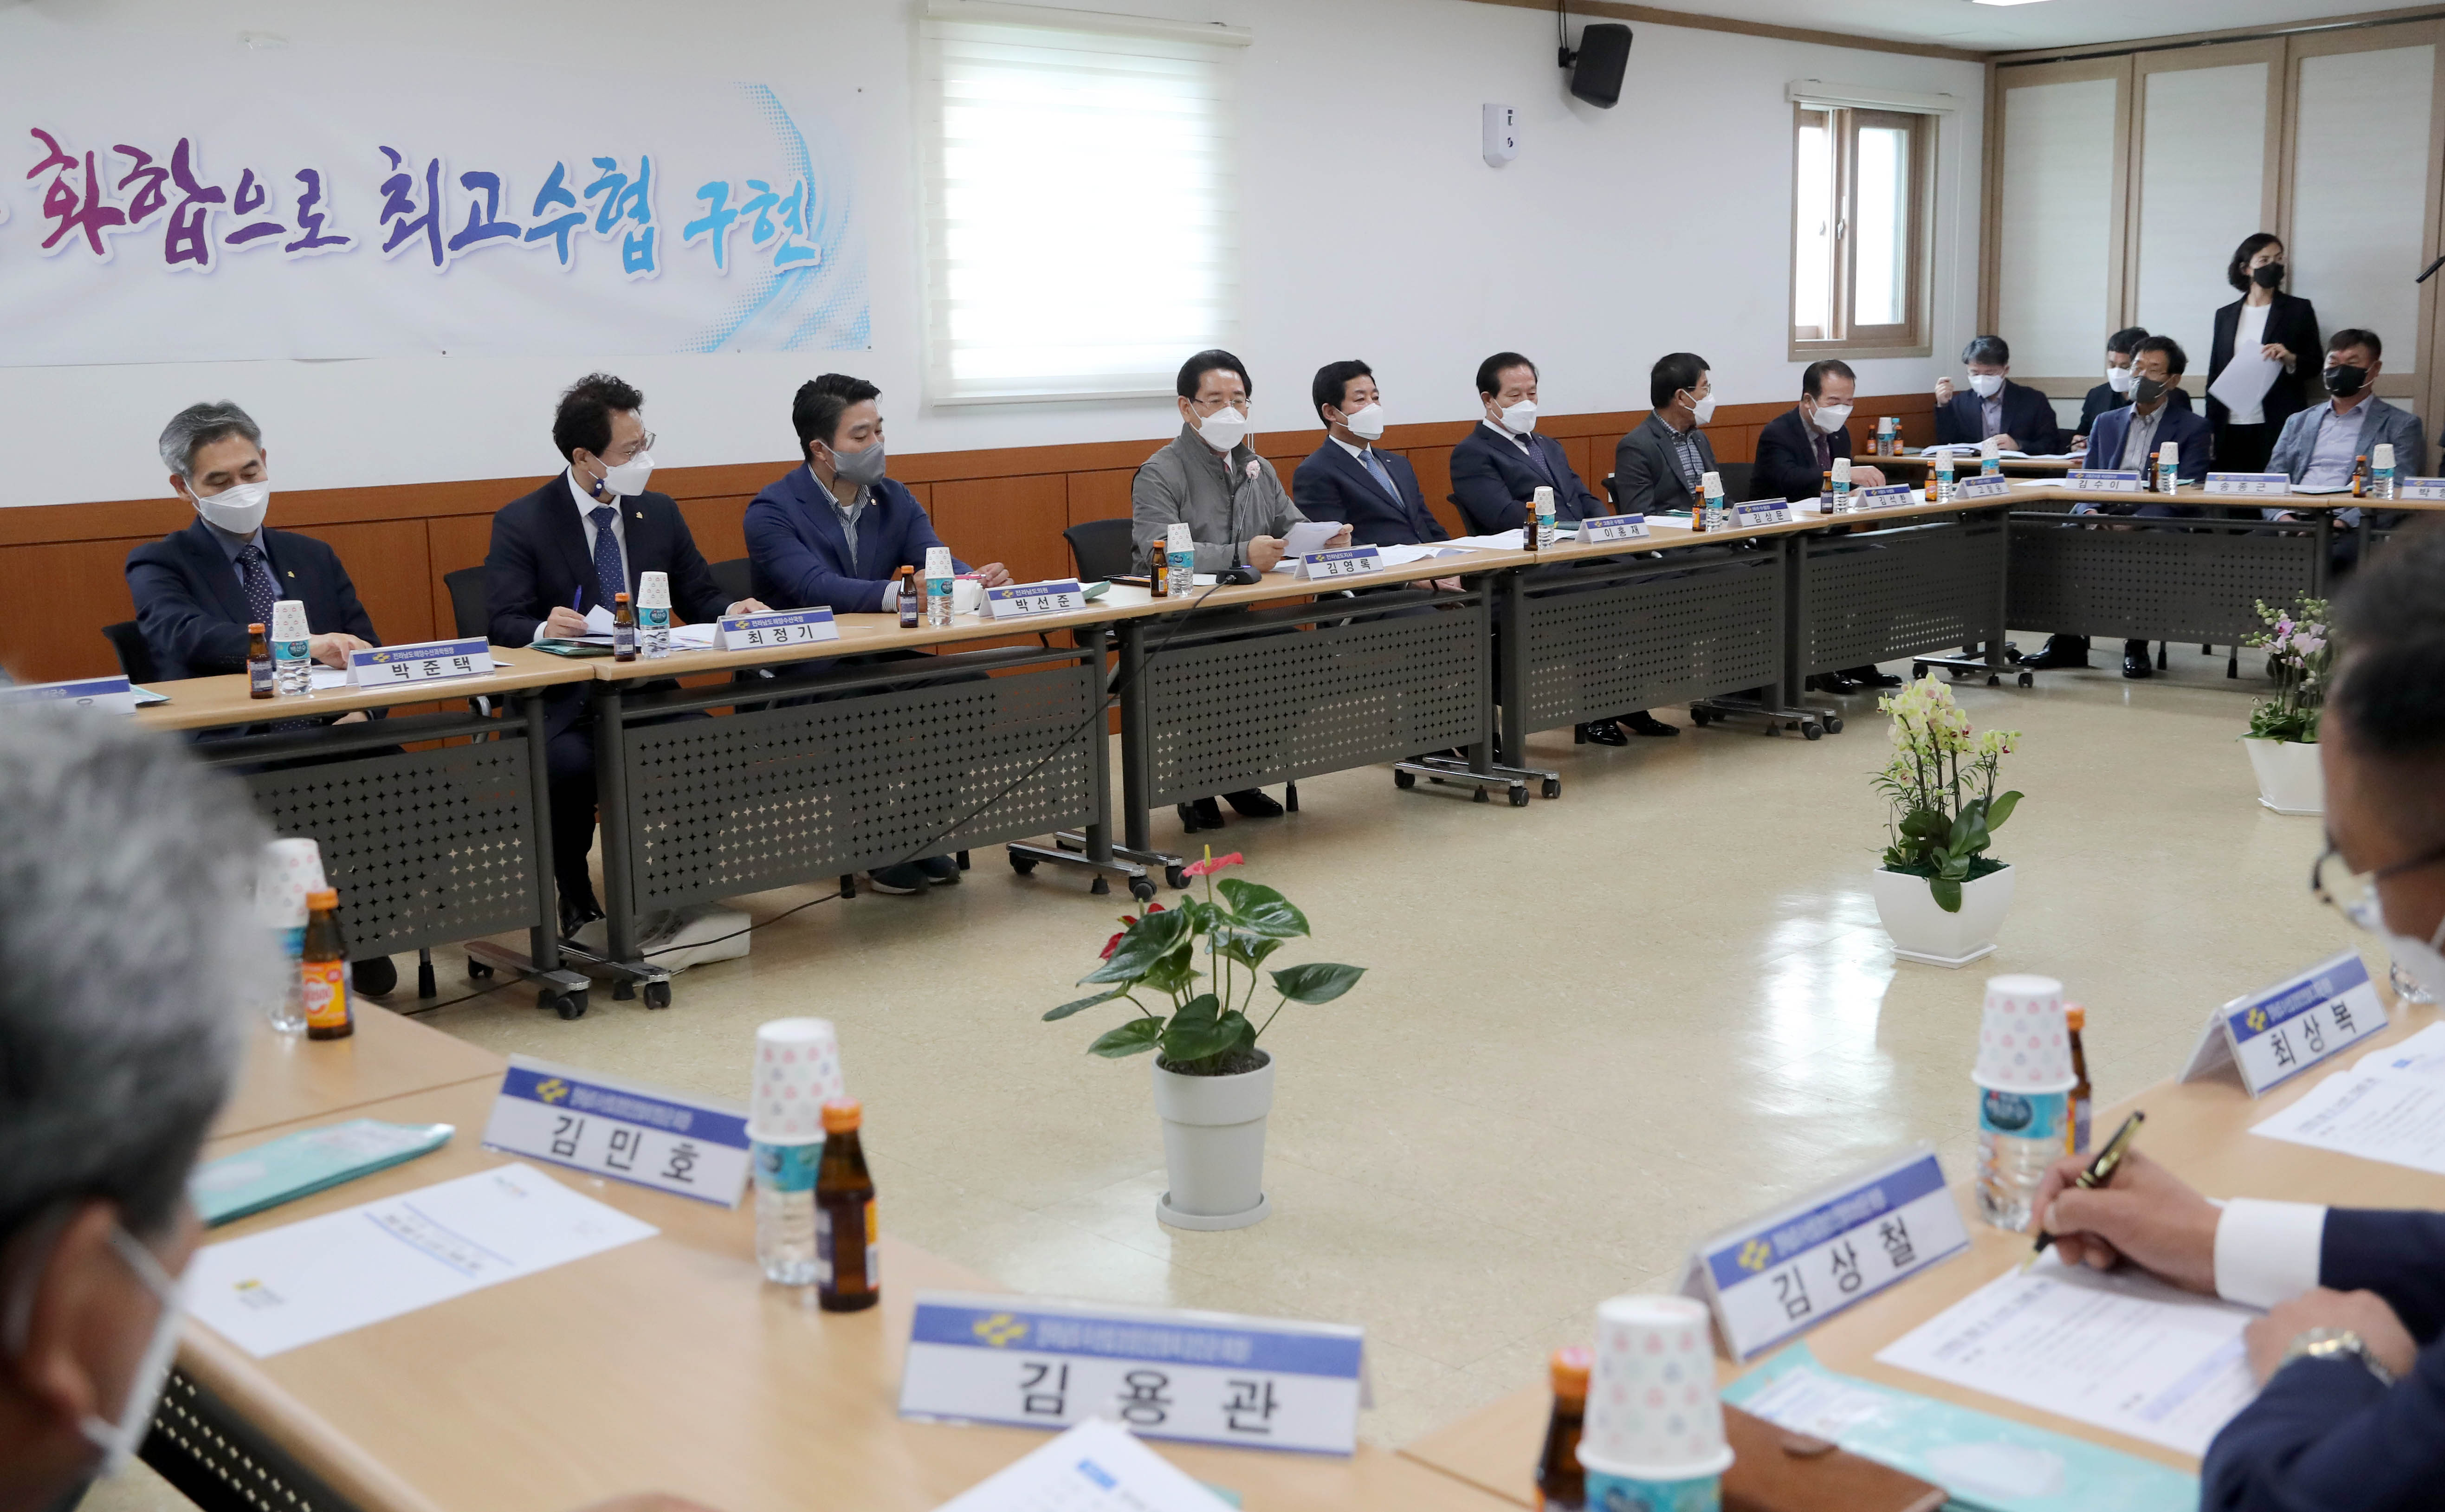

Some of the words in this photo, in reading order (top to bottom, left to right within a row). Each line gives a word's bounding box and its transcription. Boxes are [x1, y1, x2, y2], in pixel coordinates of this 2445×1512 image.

[26, 127, 351, 266] 화합으로
[379, 145, 654, 275] 최고수협
[684, 180, 815, 269] 구현
[2079, 480, 2120, 490] 김수이
[1753, 511, 1784, 523] 김상문
[1604, 525, 1640, 538] 이홍재
[1327, 558, 1371, 574] 김영록
[1016, 588, 1048, 596] 전라남도의원
[1016, 594, 1070, 612] 박선준
[748, 625, 813, 644] 최정기
[392, 656, 472, 679] 박준택
[551, 1115, 700, 1183] 김민호
[1019, 1362, 1279, 1434] 김용관
